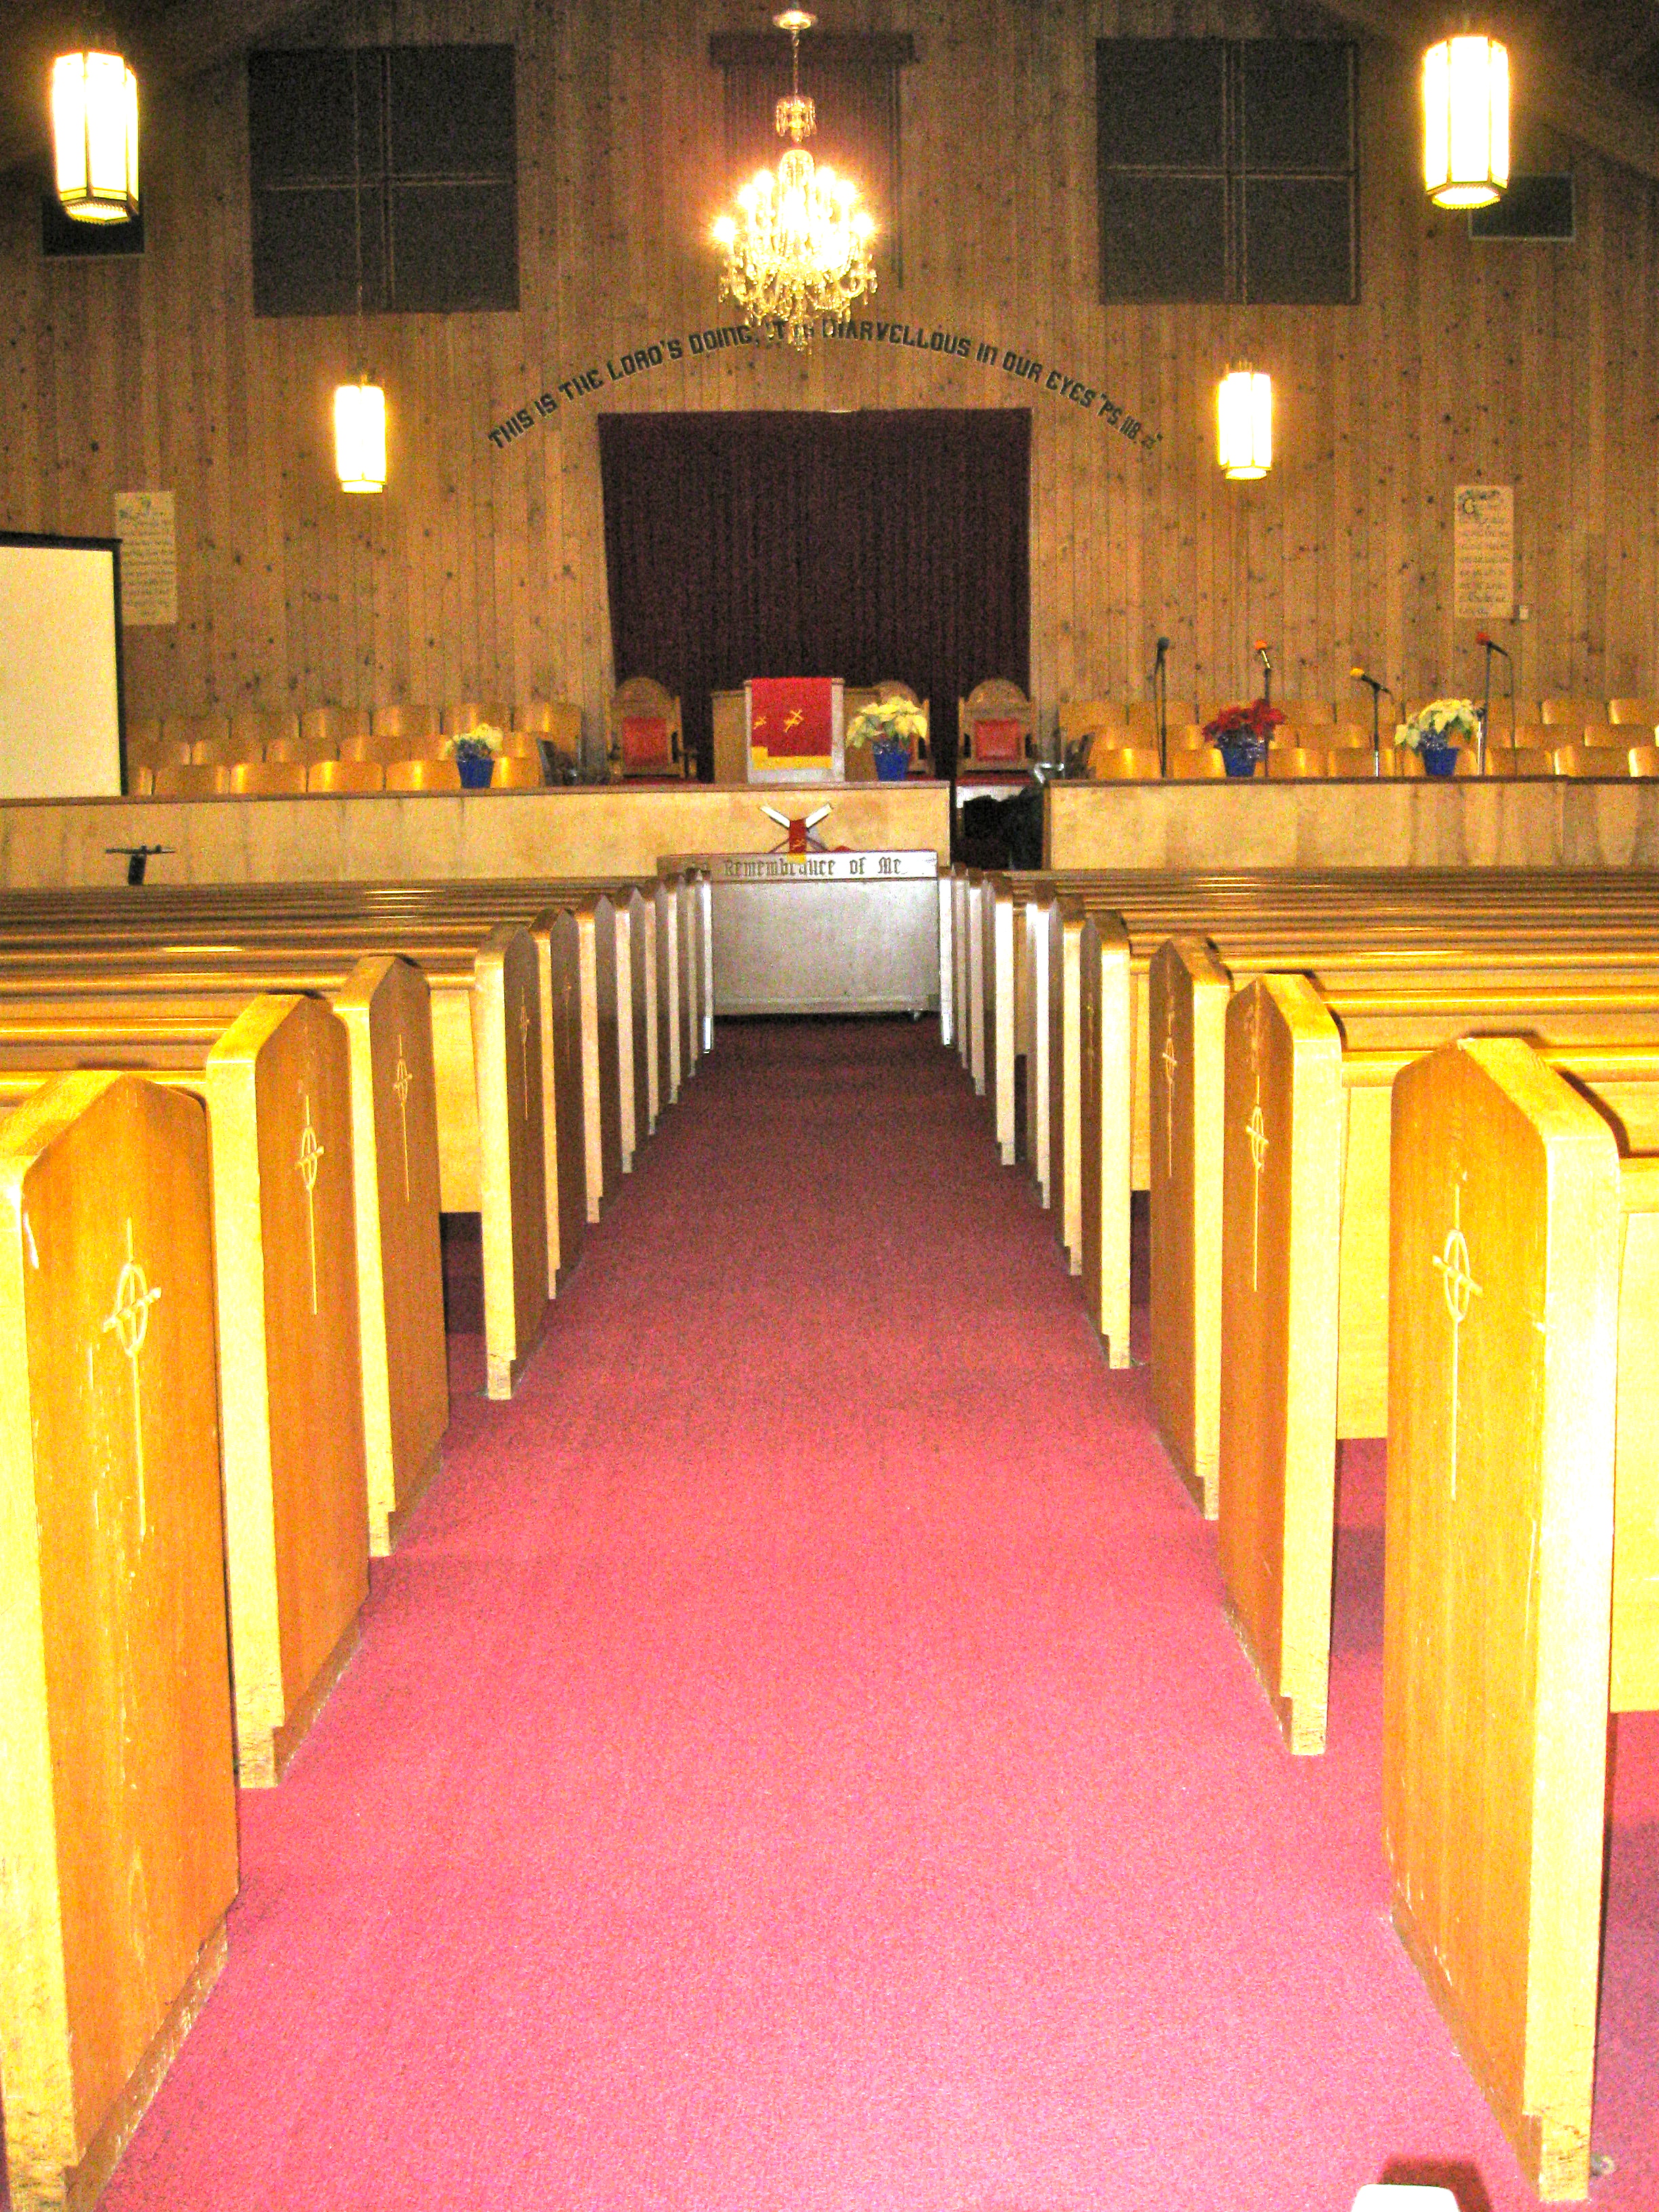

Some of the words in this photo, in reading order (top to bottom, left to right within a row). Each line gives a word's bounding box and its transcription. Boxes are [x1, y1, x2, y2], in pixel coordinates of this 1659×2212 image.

[488, 408, 535, 449] THIS
[533, 392, 557, 417] IS
[558, 369, 604, 401] THE
[607, 338, 683, 380] LORD'S
[976, 342, 998, 366] IN
[1002, 350, 1043, 383] OUR
[1046, 370, 1097, 407] EYES
[723, 857, 836, 877] Remembrance
[849, 856, 867, 875] of
[878, 856, 902, 875] Me
